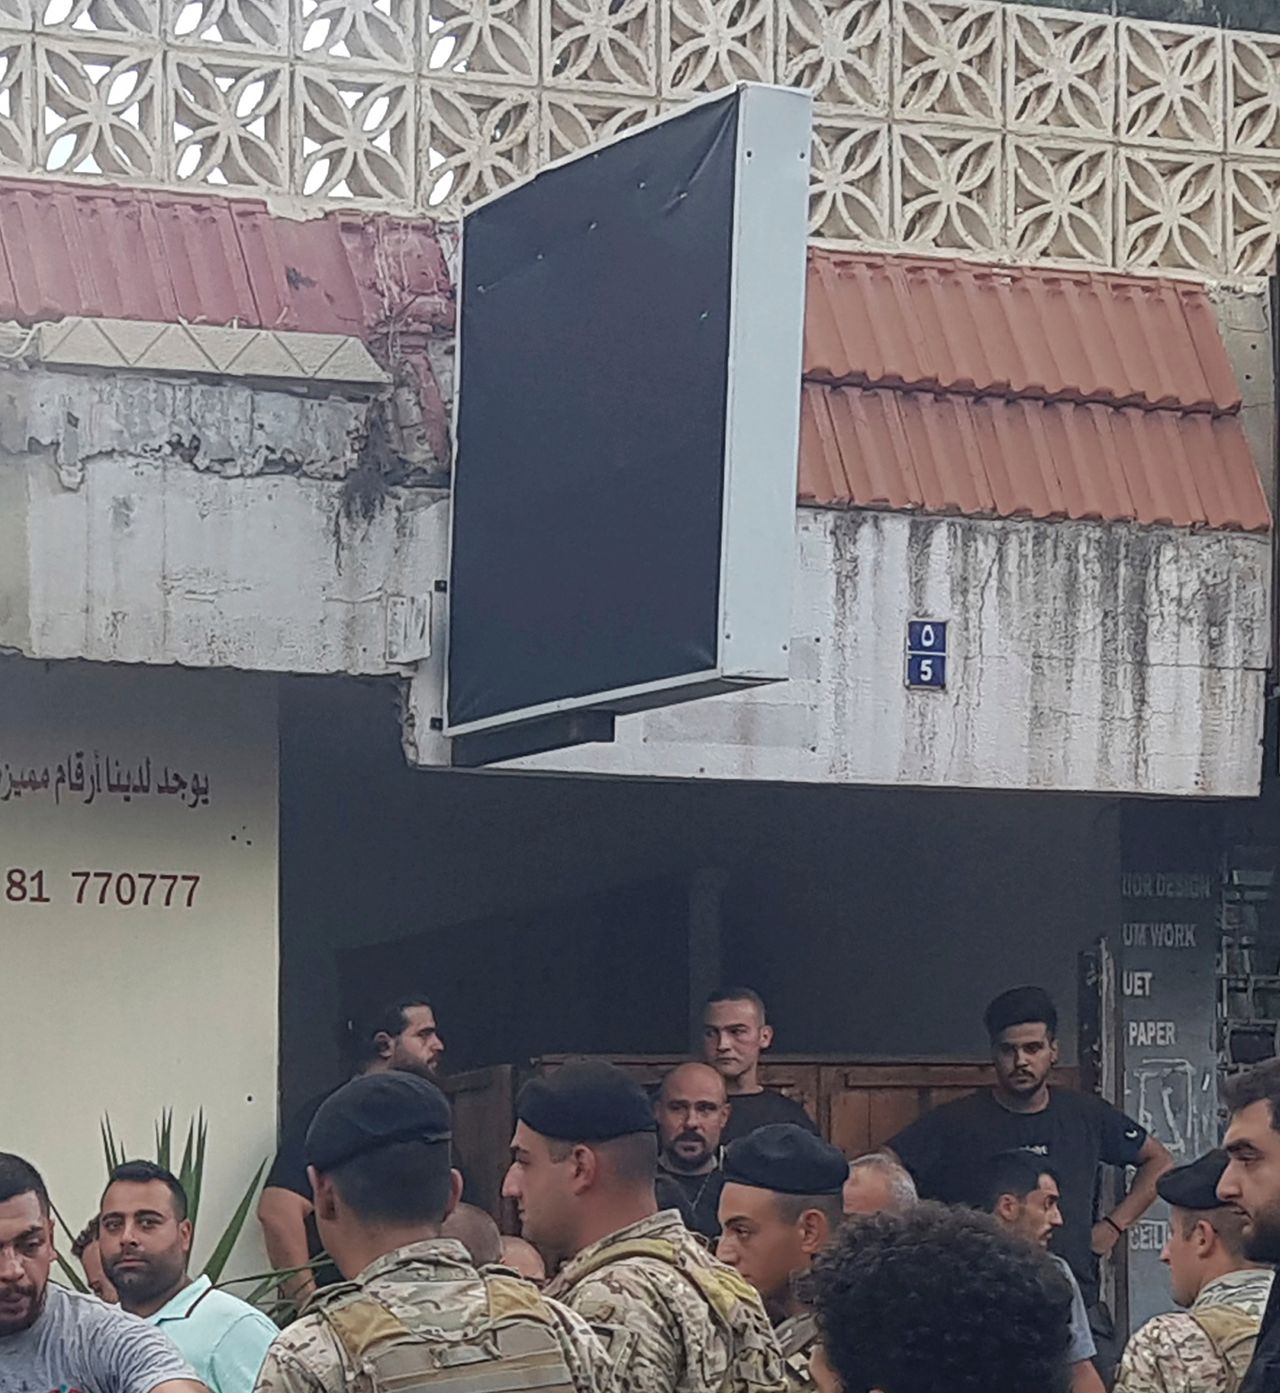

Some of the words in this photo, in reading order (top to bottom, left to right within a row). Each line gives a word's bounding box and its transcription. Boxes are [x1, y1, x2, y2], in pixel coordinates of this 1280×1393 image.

[920, 660, 933, 682] 5
[54, 750, 102, 805] أرقام
[106, 755, 151, 802] لدينا
[156, 765, 209, 808] يوجد
[5, 868, 51, 903] 81
[71, 871, 201, 908] 770777
[1149, 922, 1197, 947] WORK
[1128, 1021, 1177, 1047] PAPER
